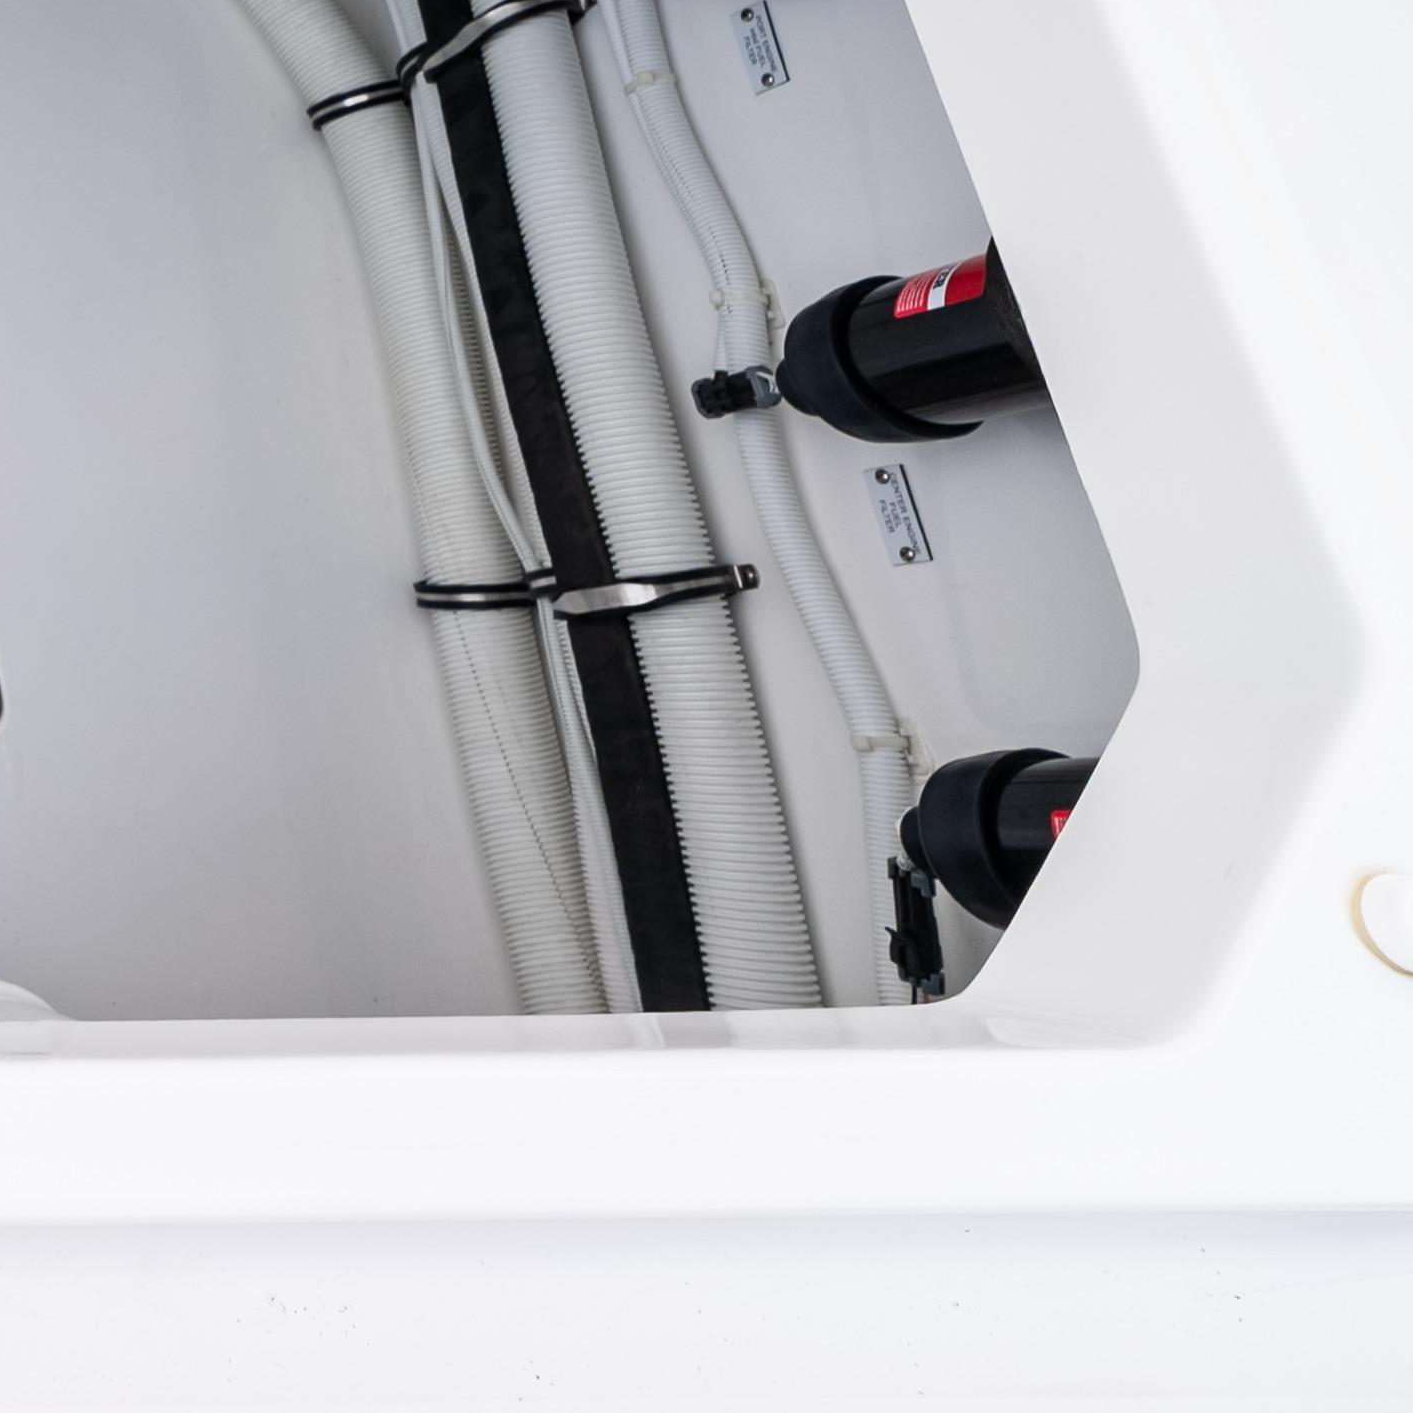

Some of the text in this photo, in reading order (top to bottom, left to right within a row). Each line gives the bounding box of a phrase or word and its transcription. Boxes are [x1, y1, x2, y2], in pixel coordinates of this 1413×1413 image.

[755, 15, 766, 38] PORT
[743, 36, 757, 64] FILTER
[755, 44, 765, 66] FUEL
[879, 500, 893, 532] FILTER
[889, 473, 920, 554] CENTER ENGINE
[889, 502, 900, 527] FUEL
